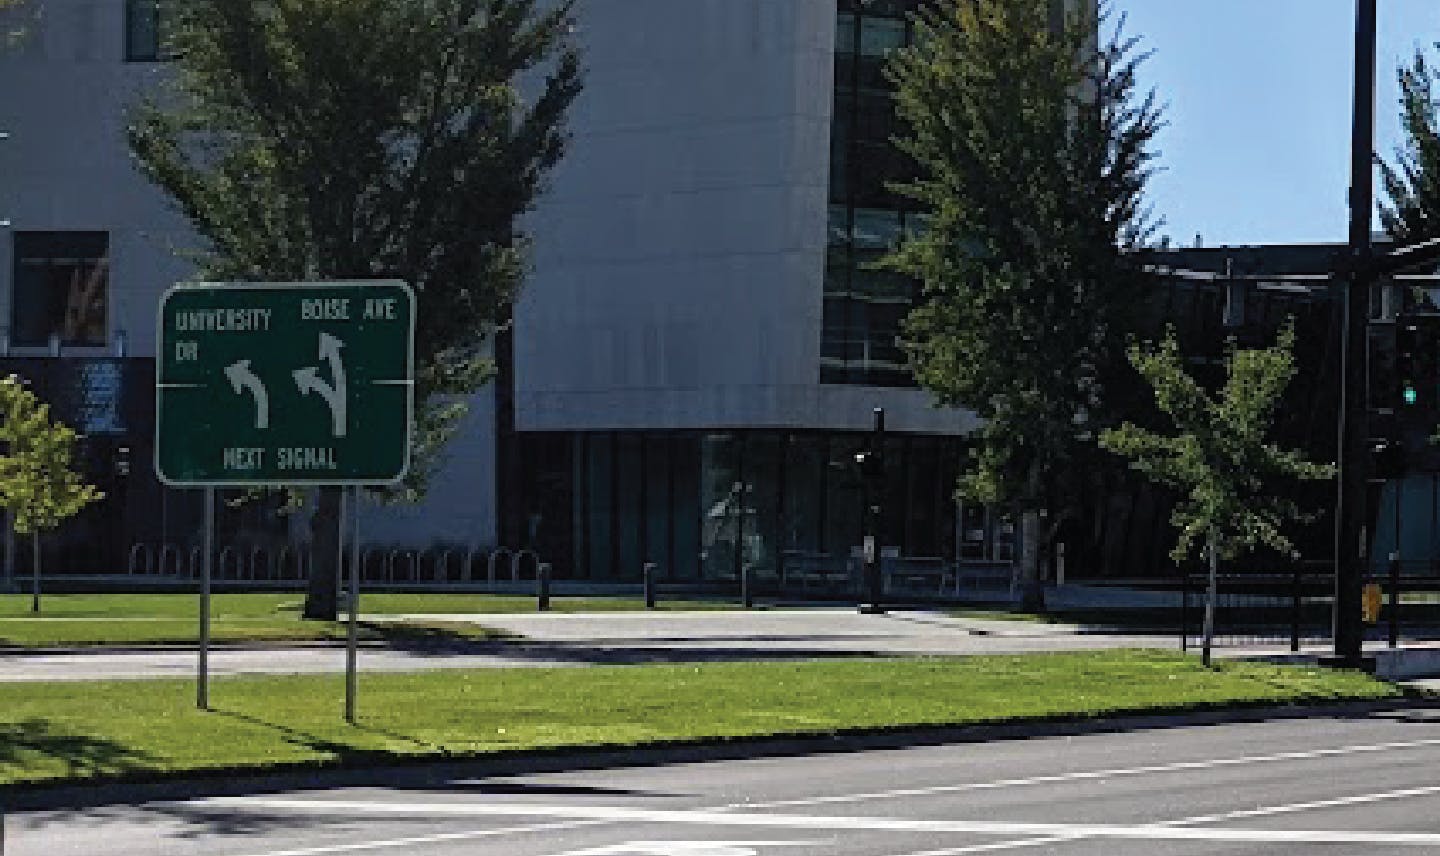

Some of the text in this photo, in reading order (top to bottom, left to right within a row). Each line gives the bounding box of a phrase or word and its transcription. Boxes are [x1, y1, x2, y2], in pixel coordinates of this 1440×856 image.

[176, 309, 271, 331] UNIVERSITY
[302, 299, 397, 320] BOISE AVE
[176, 342, 198, 361] DR
[223, 448, 337, 470] NEXT SIGNAL
